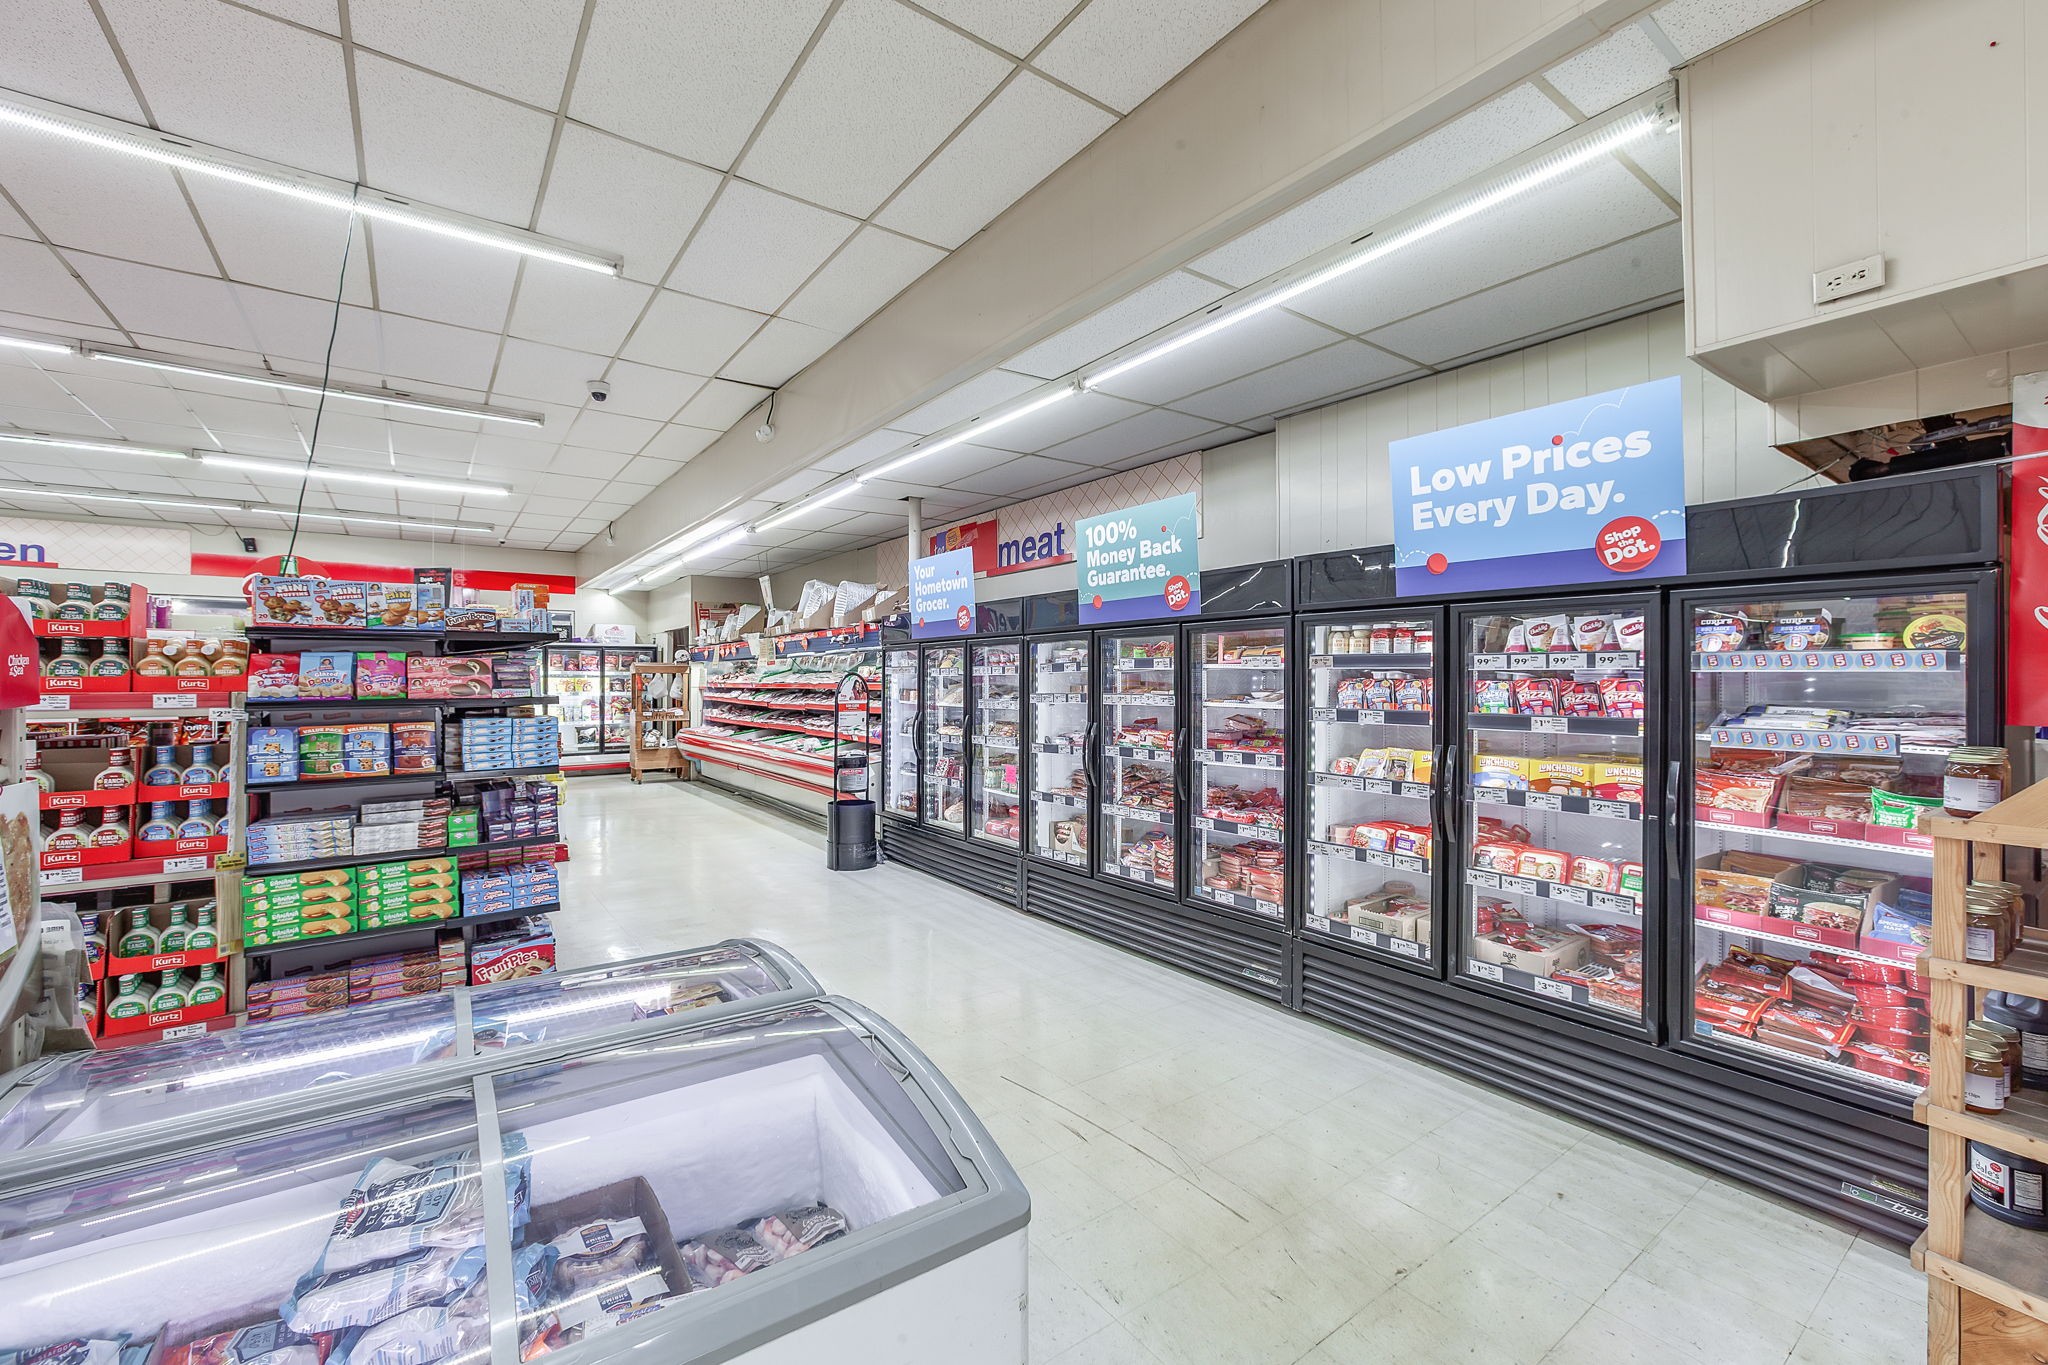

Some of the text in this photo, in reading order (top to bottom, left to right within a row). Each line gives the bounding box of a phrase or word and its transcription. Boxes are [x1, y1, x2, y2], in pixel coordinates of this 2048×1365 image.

[1410, 430, 1652, 497] Low Prices
[1412, 480, 1626, 531] Every Day.
[1085, 518, 1137, 548] 100%
[1604, 525, 1641, 545] Shop
[998, 522, 1065, 568] meat
[1617, 537, 1635, 548] the
[1086, 535, 1182, 569] Money Back
[1602, 539, 1656, 566] Dot.
[914, 565, 935, 580] Your
[1087, 562, 1171, 588] Guarantee.
[915, 574, 968, 598] Hometown
[1167, 581, 1183, 594] Shop
[1167, 591, 1189, 606] Dot.
[915, 598, 949, 613] Grocer.
[51, 624, 80, 632] Kurtz
[8, 654, 30, 667] Chicken
[1709, 657, 1718, 666] 5
[1732, 657, 1742, 666] 5
[1757, 657, 1767, 666] 5
[1783, 657, 1793, 666] 5
[1808, 657, 1818, 666] 5
[1836, 656, 1846, 666] 5
[1864, 656, 1875, 666] 5
[1893, 655, 1904, 666] 5
[1924, 656, 1936, 666] 5
[181, 680, 207, 688] Kurtz
[1719, 733, 1728, 742] 5
[1743, 734, 1752, 744] 5
[1768, 735, 1778, 745] 5
[1793, 735, 1803, 746] 5
[1819, 736, 1830, 747] 5
[1847, 737, 1859, 749] 5
[1876, 739, 1888, 750] 5
[1479, 758, 1519, 770] LUNCHABLES
[1539, 763, 1584, 777] LUNCHABLES
[183, 787, 210, 795] Kurtz
[52, 796, 83, 805] Kurtz
[56, 839, 78, 847] RANCH
[180, 840, 206, 849] Kurtz
[47, 853, 78, 864] Kurtz
[155, 957, 183, 966] Kurtz
[1502, 952, 1517, 960] BAR
[152, 1013, 179, 1023] Kurtz
